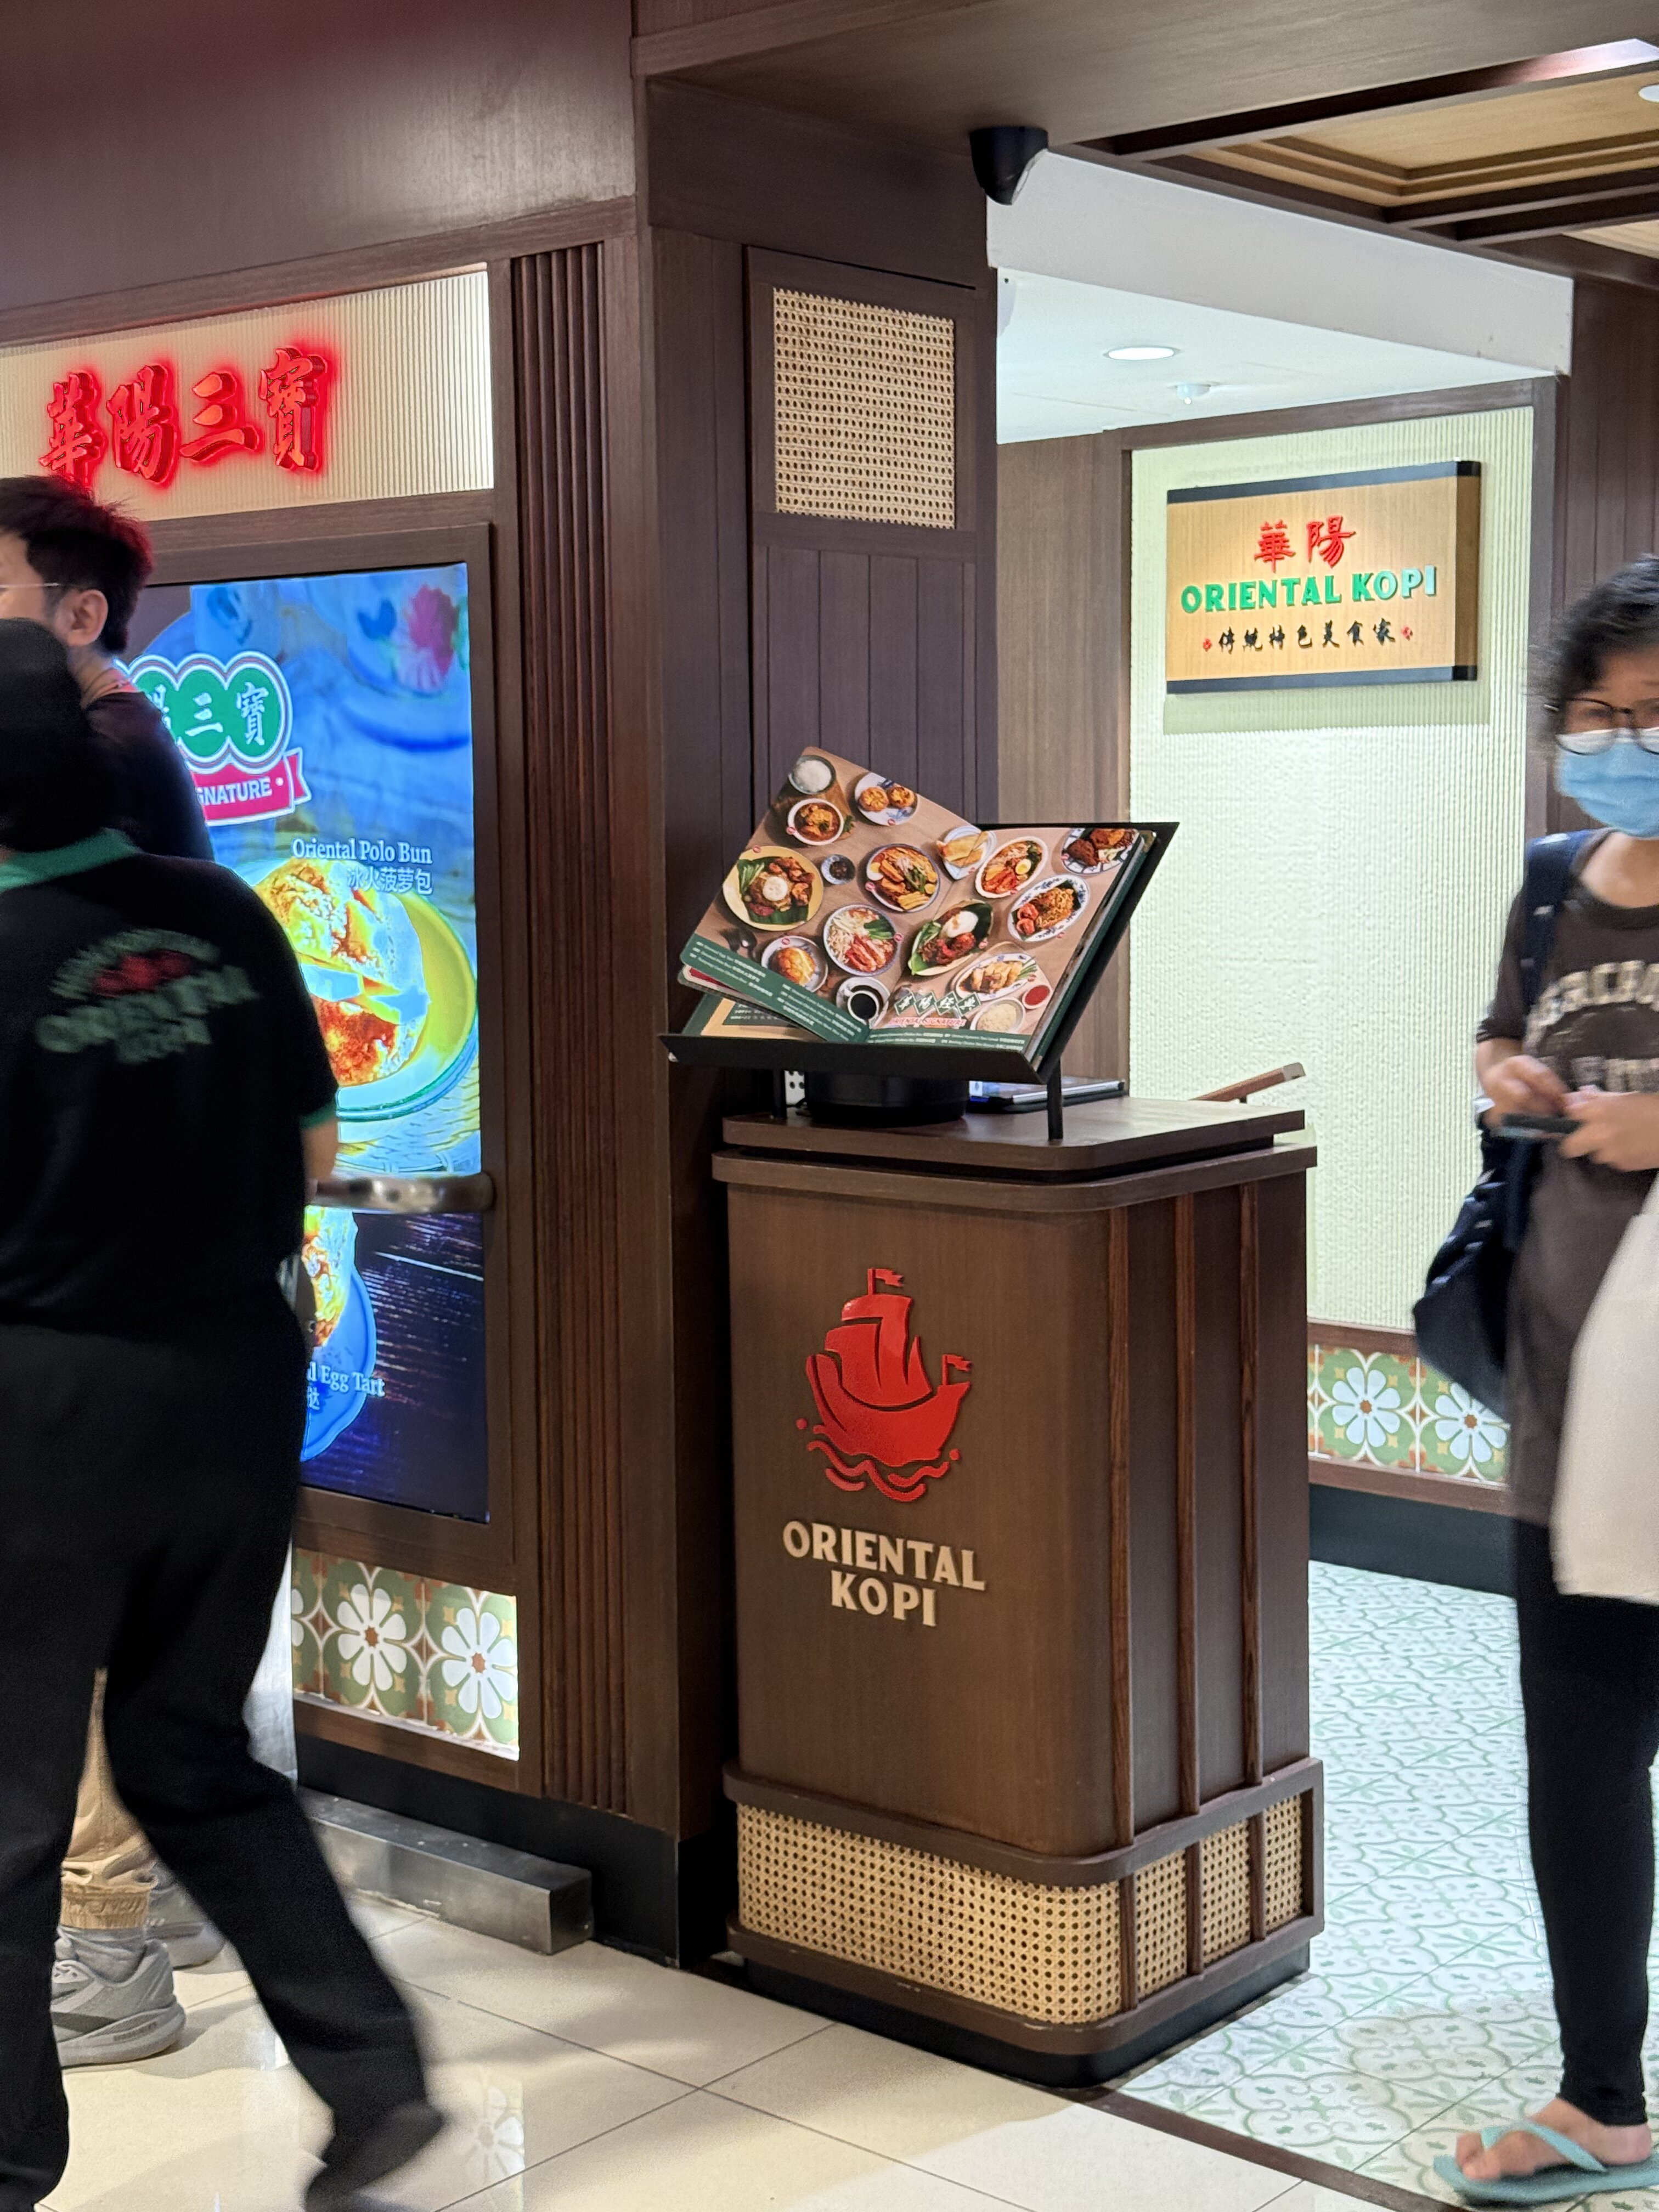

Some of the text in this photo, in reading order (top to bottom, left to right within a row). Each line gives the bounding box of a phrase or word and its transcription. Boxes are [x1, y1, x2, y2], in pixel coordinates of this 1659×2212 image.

[1254, 515, 1357, 573] 華陽
[1181, 565, 1437, 613] ORIENTAL KOPI
[151, 682, 269, 746] 三寶
[196, 776, 273, 806] GNATURE
[292, 838, 433, 864] Oriental Polo Bun
[321, 1365, 349, 1393] Egg
[352, 1372, 385, 1397] Tart
[783, 1521, 986, 1627] ORIENTAL KOPI
